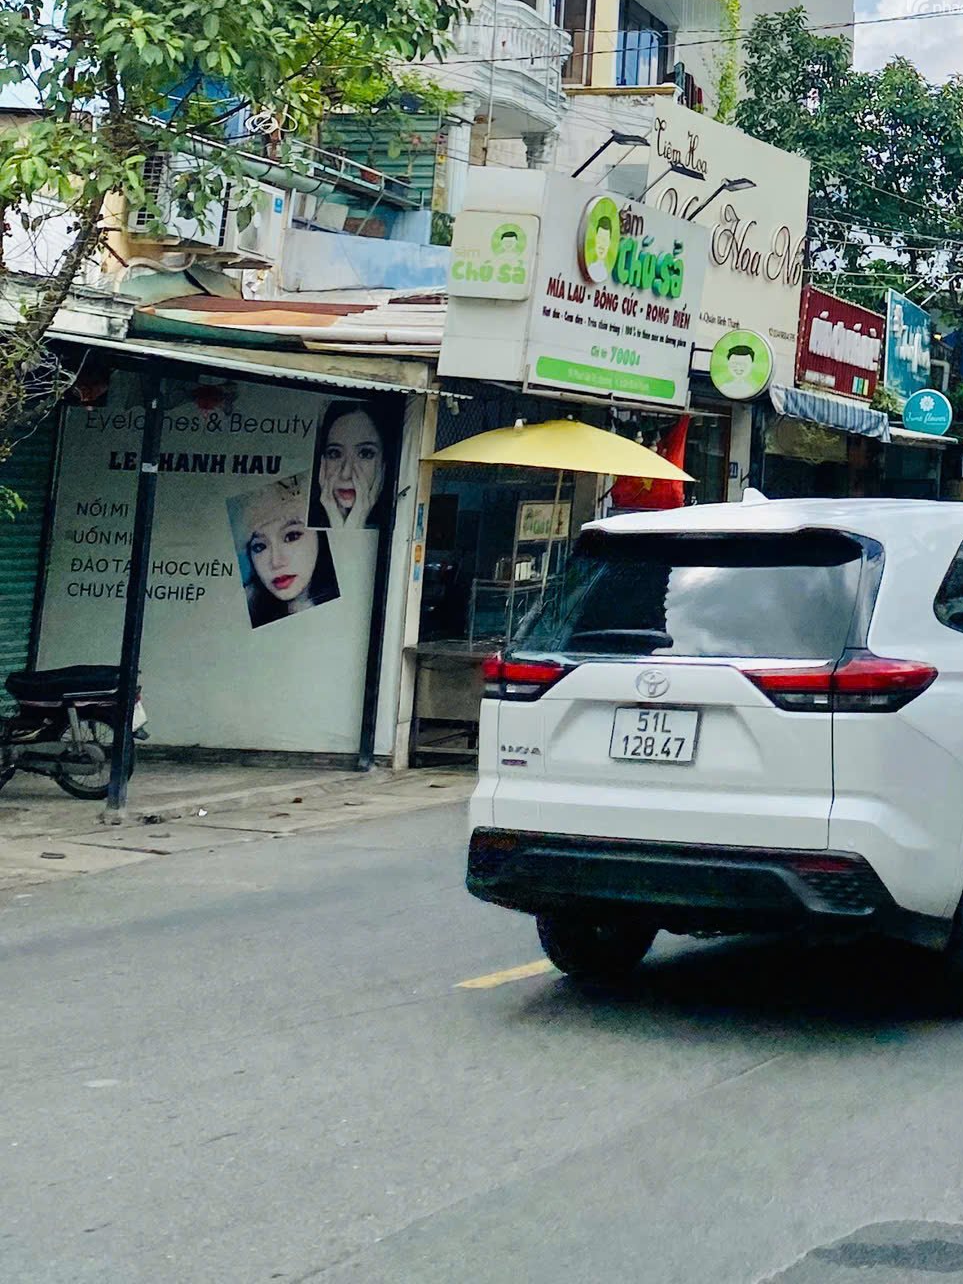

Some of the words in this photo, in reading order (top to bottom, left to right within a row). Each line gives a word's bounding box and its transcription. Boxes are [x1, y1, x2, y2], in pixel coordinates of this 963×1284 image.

[685, 130, 708, 175] Hoa
[709, 203, 762, 277] Hoa
[451, 259, 495, 283] Chú
[612, 235, 656, 290] Chú
[546, 273, 565, 301] MÍA
[567, 282, 586, 304] LAU
[593, 286, 619, 313] BÔNG
[621, 292, 638, 318] CÚC
[206, 413, 223, 433] &
[229, 413, 314, 438] Beauty
[108, 451, 137, 471] LE
[156, 451, 227, 474] HANH
[231, 454, 283, 475] HAU
[76, 497, 107, 517] NỐI
[110, 503, 129, 517] MI
[73, 525, 112, 545] UỐN
[194, 558, 233, 577] VIÊN
[67, 580, 126, 598] CHUYÊ
[637, 710, 671, 733] 51L
[622, 735, 686, 759] 128.47
